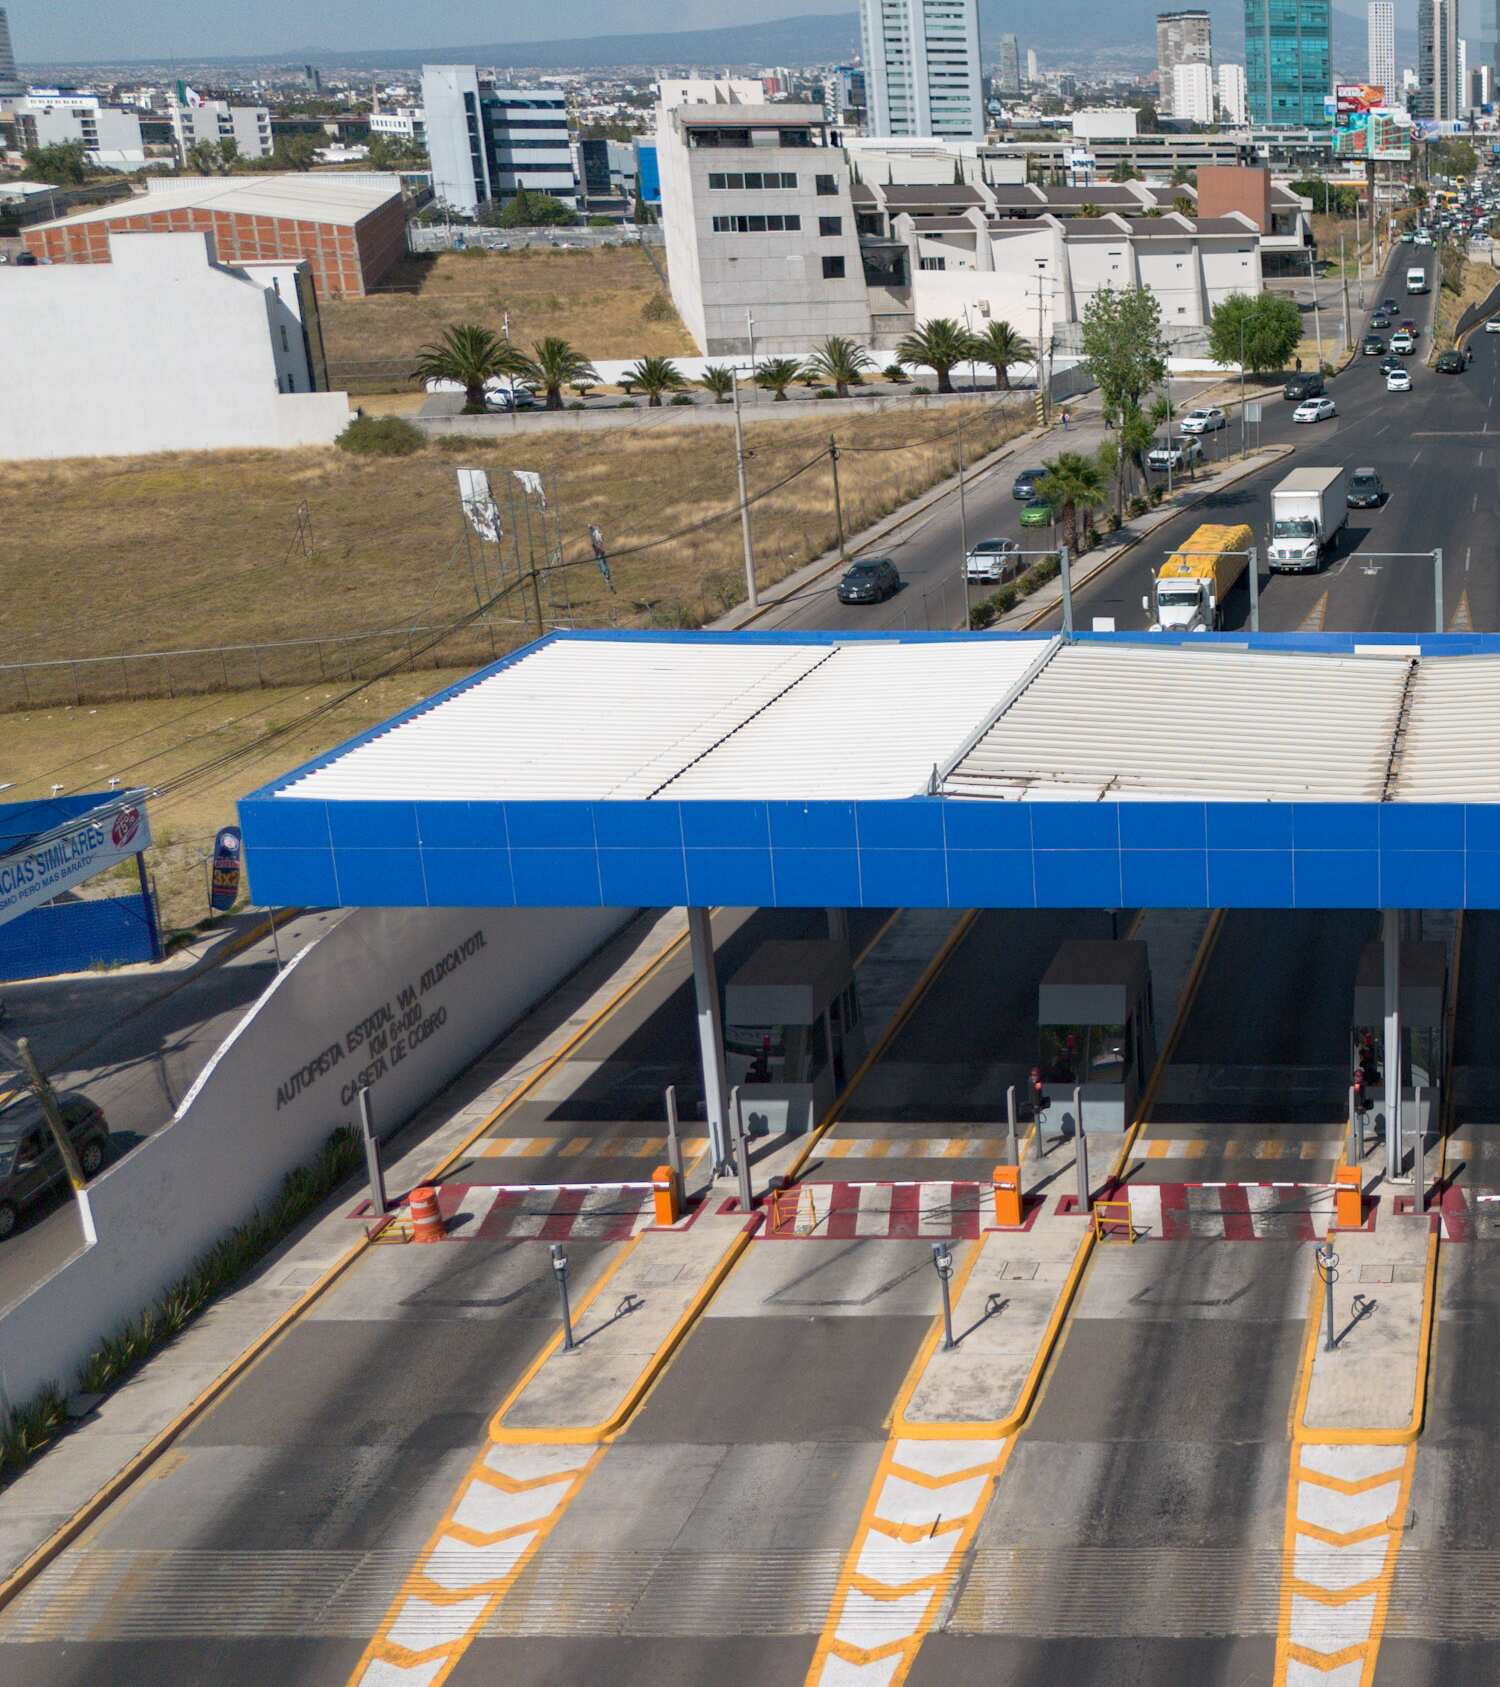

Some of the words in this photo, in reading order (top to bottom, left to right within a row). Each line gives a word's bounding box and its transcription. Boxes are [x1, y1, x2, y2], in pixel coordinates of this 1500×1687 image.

[0, 857, 35, 896] CIAS
[36, 826, 105, 875] SIMILARES
[19, 881, 41, 899] PERO
[275, 1042, 346, 1111] AUTOPISTA
[346, 1002, 395, 1052] ESTATAL
[396, 985, 418, 1011] VIA
[420, 929, 488, 996] ATLIXCAYOTL
[368, 1034, 388, 1060] KM
[390, 1002, 422, 1041] 6+000
[340, 1055, 389, 1106] CASETA
[390, 1037, 407, 1068] DE
[408, 1005, 448, 1050] COBRO
